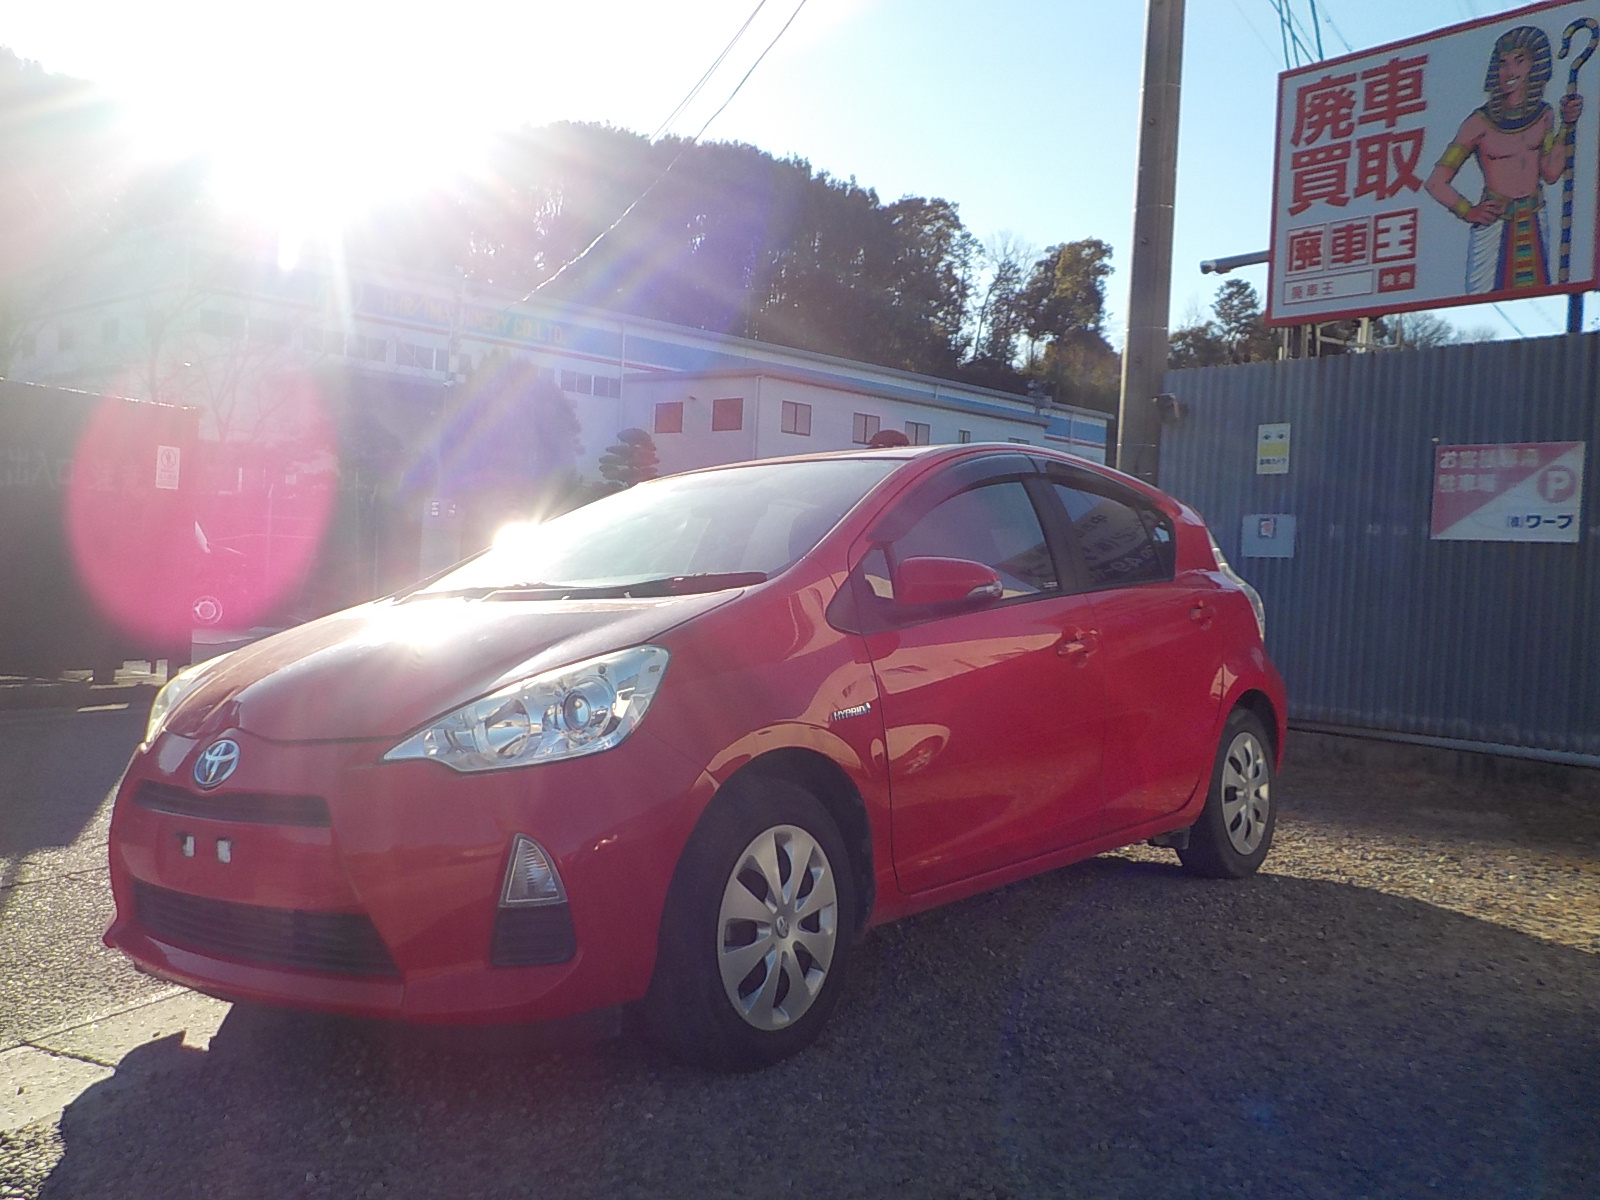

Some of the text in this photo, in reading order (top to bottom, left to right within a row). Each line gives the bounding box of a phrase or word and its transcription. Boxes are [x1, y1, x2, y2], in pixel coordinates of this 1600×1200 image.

[1290, 54, 1429, 146] 廃車
[1288, 126, 1426, 216] 買取
[1288, 208, 1418, 273] 廃車王
[1291, 281, 1334, 299] 廃車王
[1546, 470, 1571, 500] P
